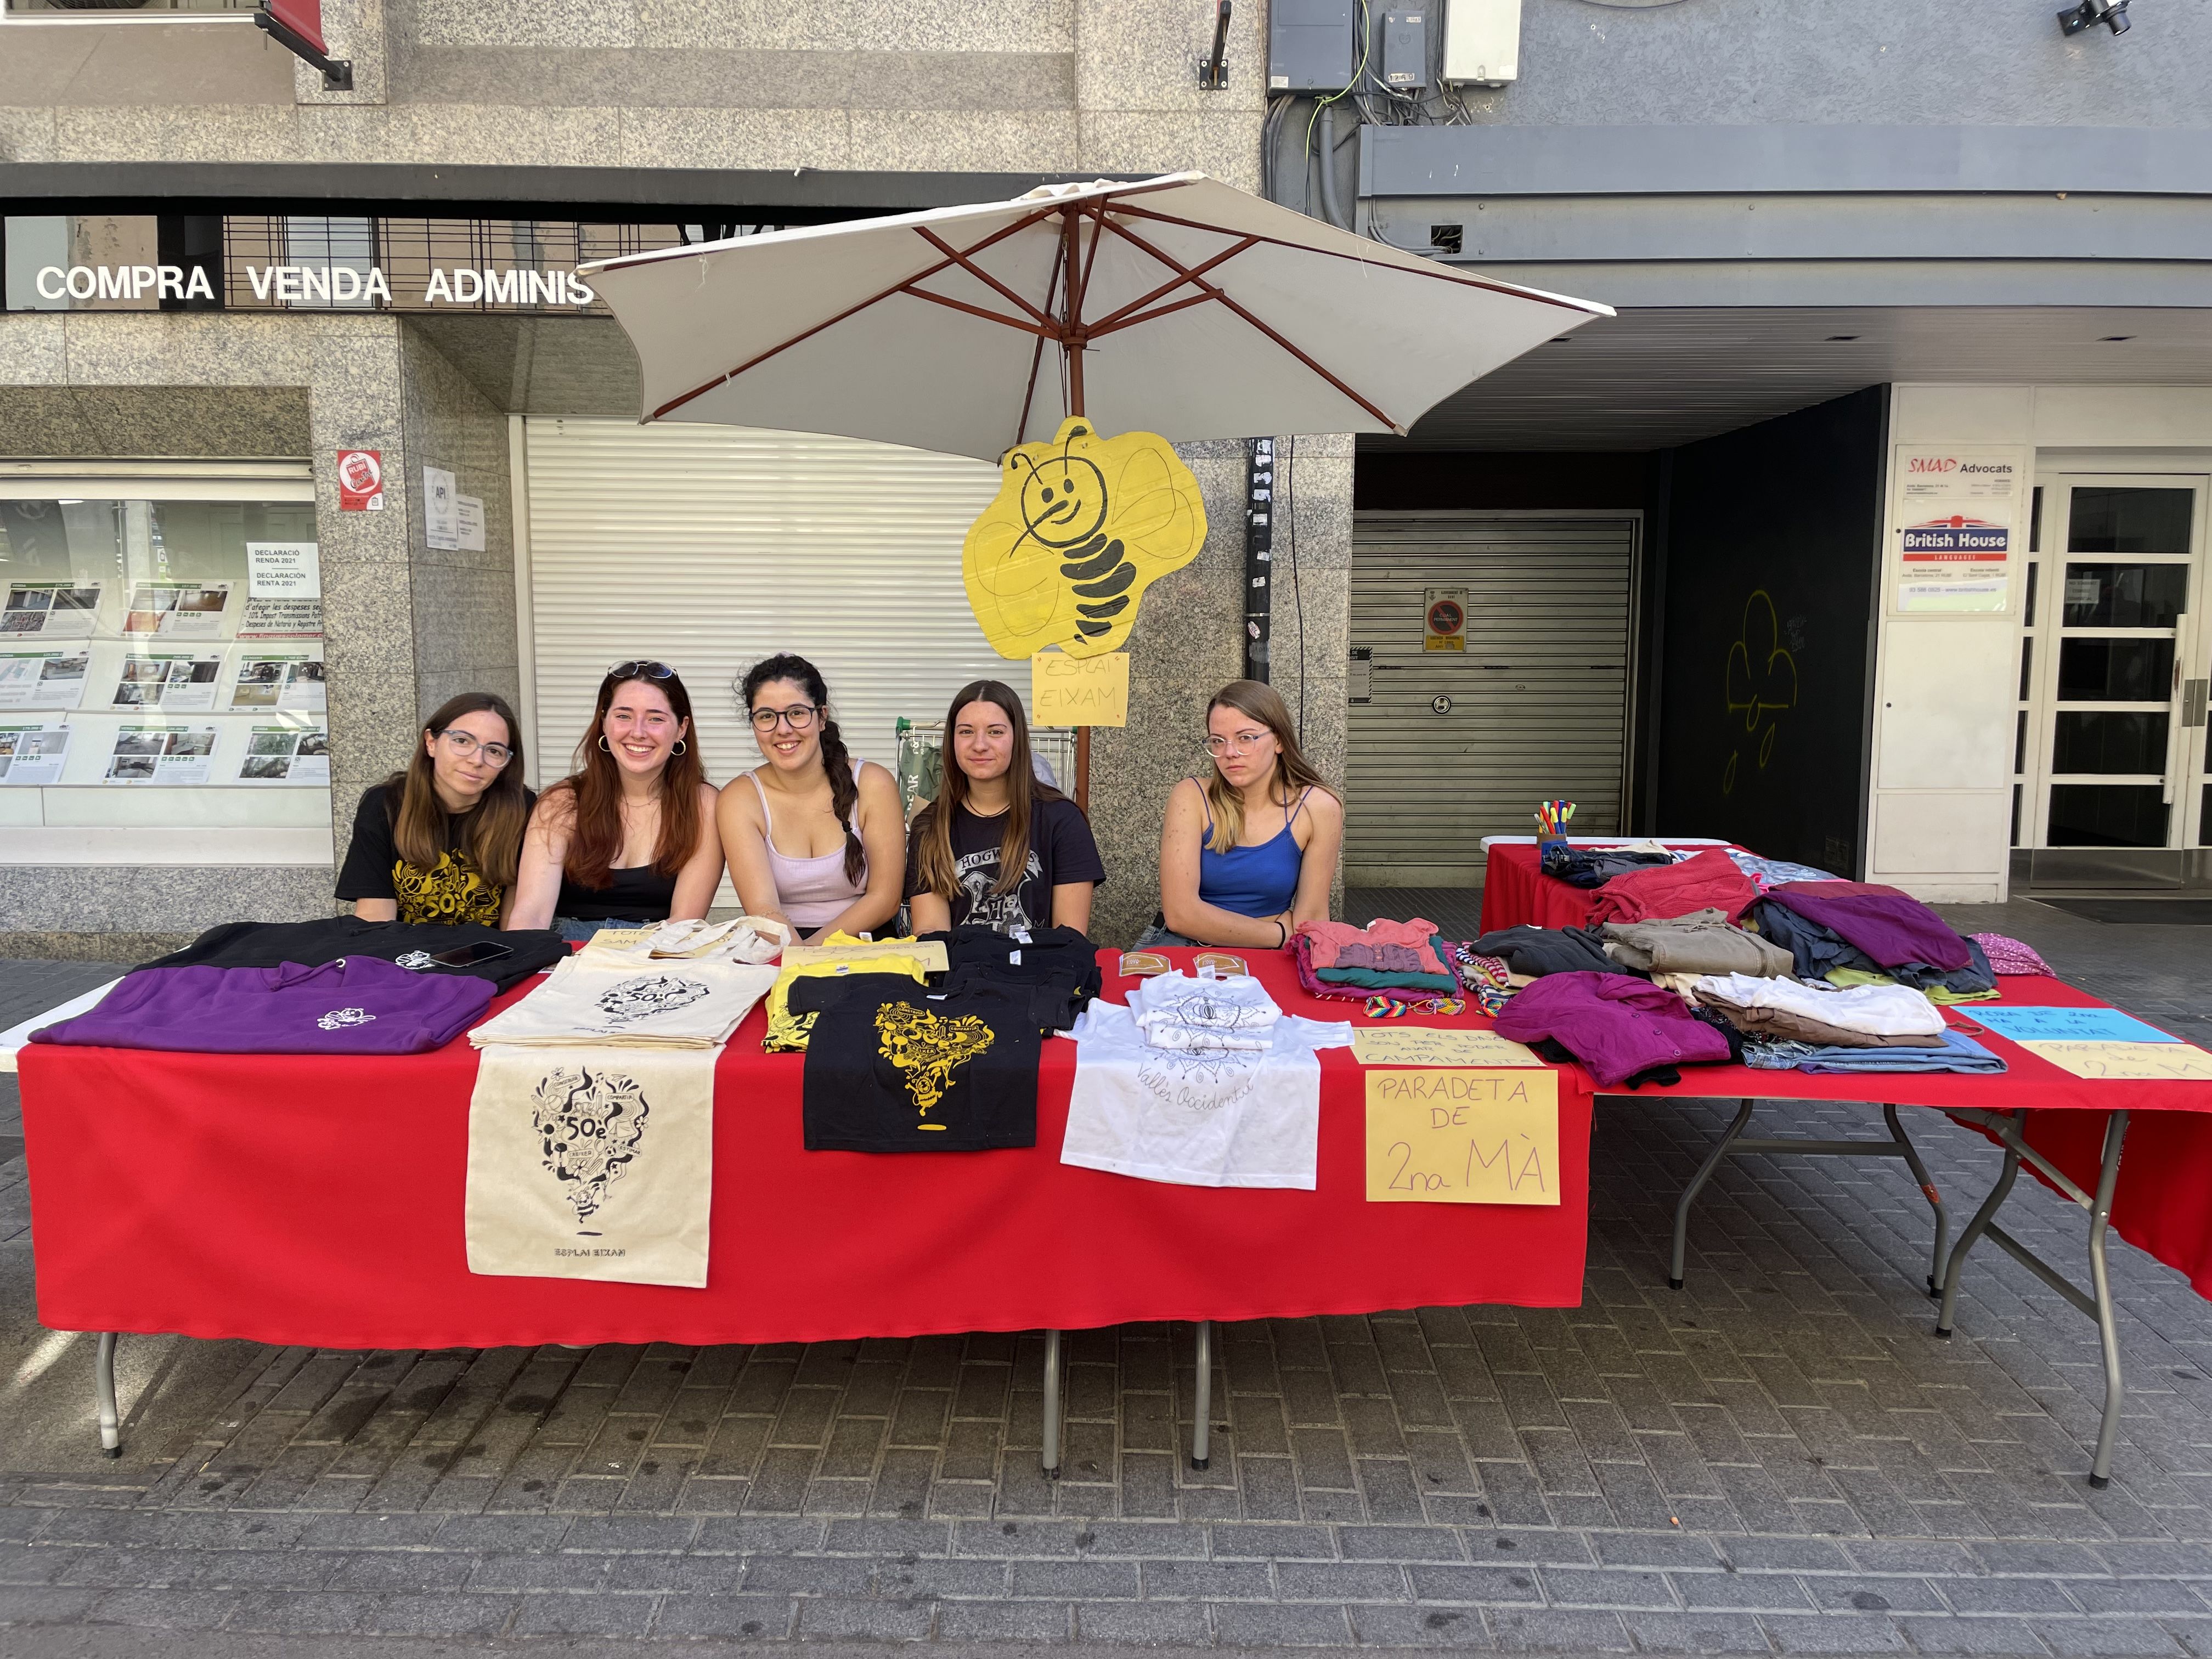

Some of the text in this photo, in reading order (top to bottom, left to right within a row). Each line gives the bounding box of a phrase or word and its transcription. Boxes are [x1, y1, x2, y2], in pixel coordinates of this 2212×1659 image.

[36, 265, 215, 301] COMPRA
[246, 266, 392, 302] VENDA
[1908, 458, 2013, 473] SMAD Advocats
[436, 486, 446, 499] API
[1905, 533, 2007, 548] British House
[283, 603, 311, 612] despeses
[297, 620, 316, 629] Registre
[1046, 659, 1110, 676] ESPLAI
[1040, 687, 1115, 709] EIXAM
[961, 849, 1036, 868] HOGWS
[1353, 1029, 1411, 1039] TOTS
[1426, 1032, 1458, 1041] ELS
[2002, 1025, 2117, 1036] VOLUNTAT
[2039, 1043, 2188, 1053] PARADETA
[1365, 1053, 1540, 1065] CAMPAMENTS
[2157, 1058, 2212, 1077] M
[1377, 1076, 1528, 1103] PARADETA
[1431, 1106, 1470, 1128] DE
[1388, 1133, 1545, 1192] 2na MÀ
